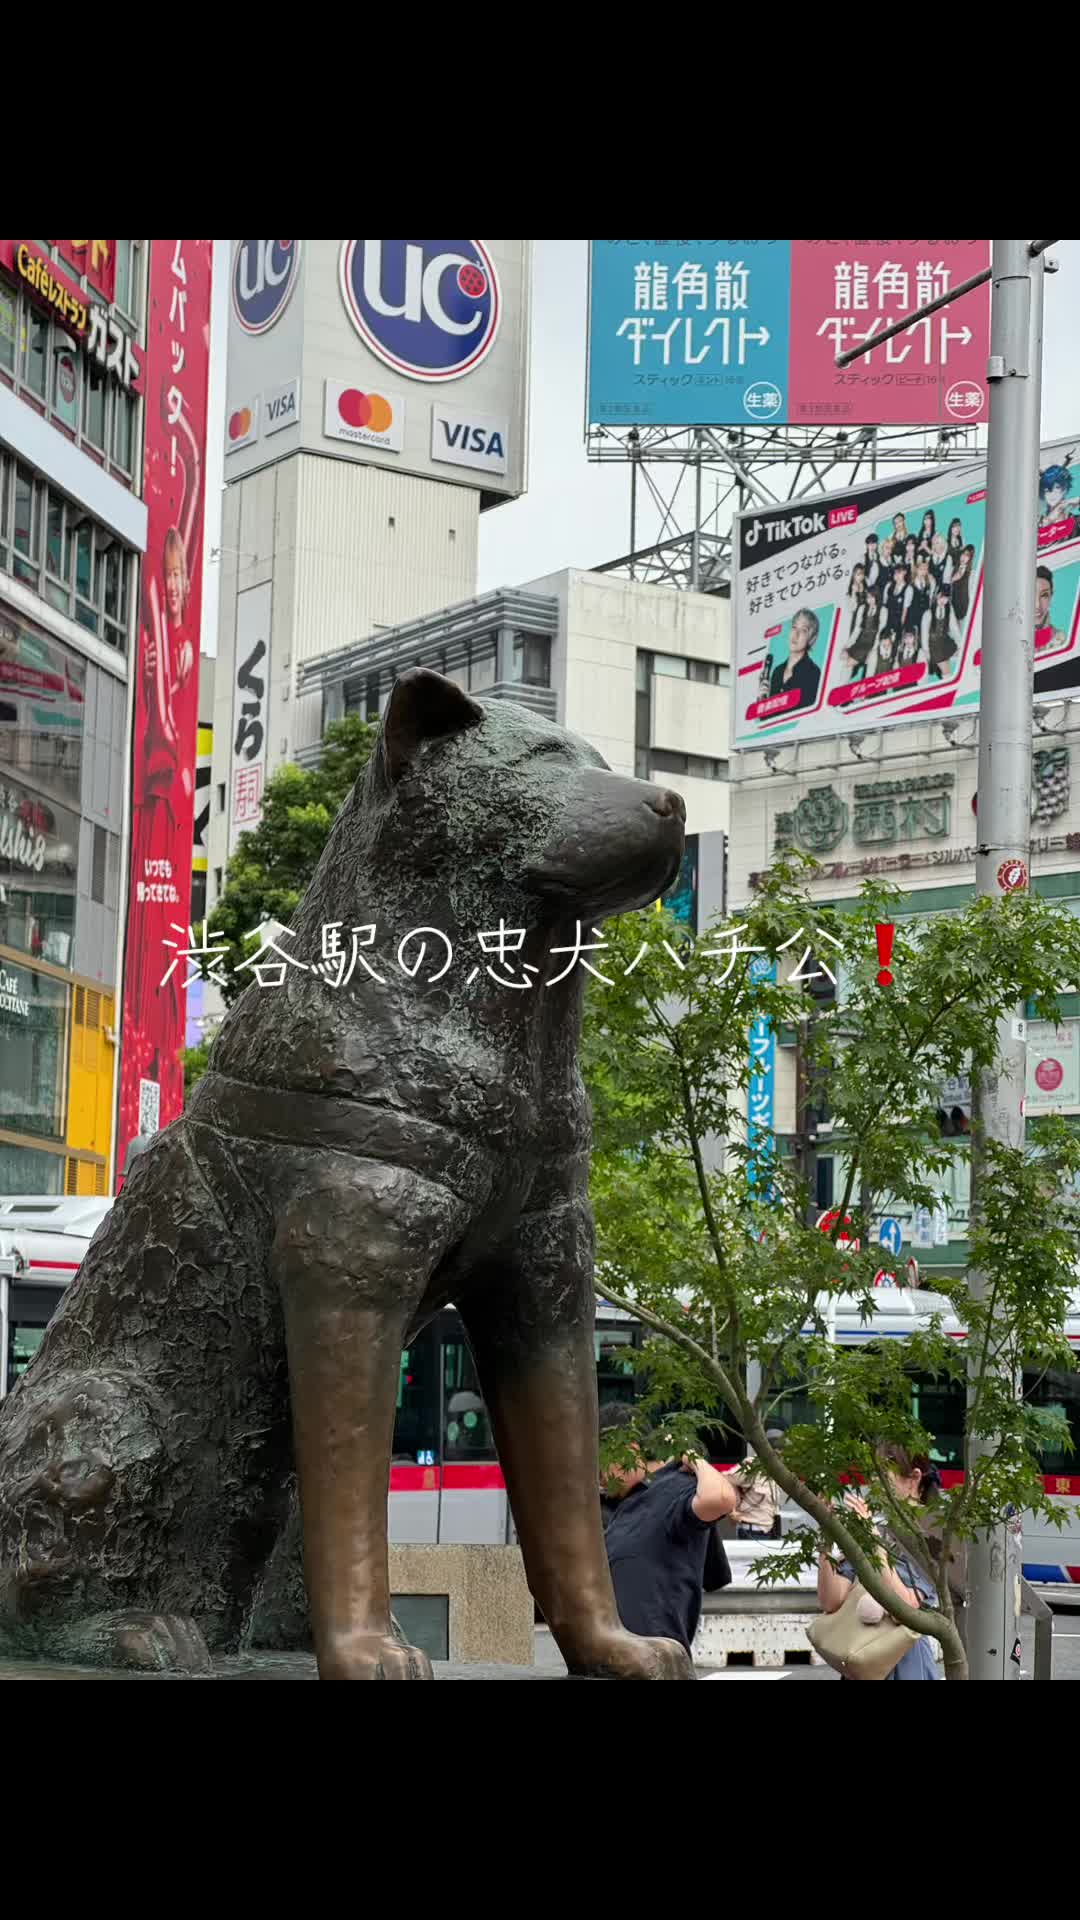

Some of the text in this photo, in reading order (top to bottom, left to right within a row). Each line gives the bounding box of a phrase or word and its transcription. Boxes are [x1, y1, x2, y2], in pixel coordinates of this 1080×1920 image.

[634, 261, 750, 311] 龍角散
[834, 261, 951, 310] 龍角散
[88, 304, 140, 387] ガスト
[616, 317, 771, 365] ダイレクト
[816, 317, 973, 366] ダイレクト
[266, 394, 296, 420] VISA
[746, 392, 779, 408] 生薬
[948, 391, 982, 408] 生薬
[339, 427, 391, 446] mastercard
[438, 418, 505, 458] VISA
[765, 509, 856, 542] TikTok LIVE
[746, 543, 848, 594] 好きでつながる。
[749, 564, 851, 616] 好きでひろがる。
[144, 859, 172, 879] いつでも
